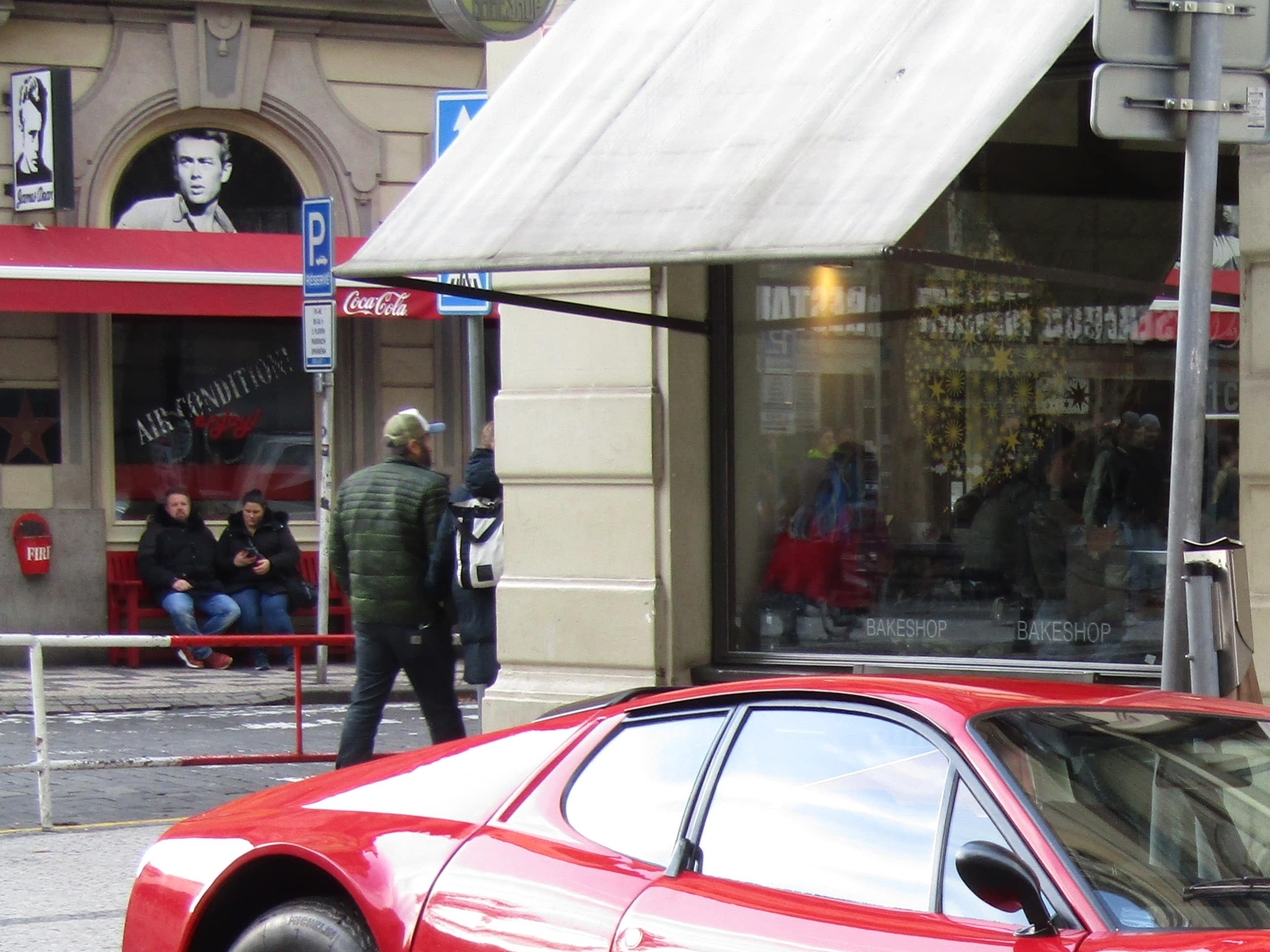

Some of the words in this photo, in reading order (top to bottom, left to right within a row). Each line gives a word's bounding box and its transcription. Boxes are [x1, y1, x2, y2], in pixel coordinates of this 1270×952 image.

[309, 211, 326, 267] P
[343, 290, 411, 317] Coca-Cola
[866, 618, 948, 638] BAKESHOP
[1017, 620, 1112, 644] BAKESHOP
